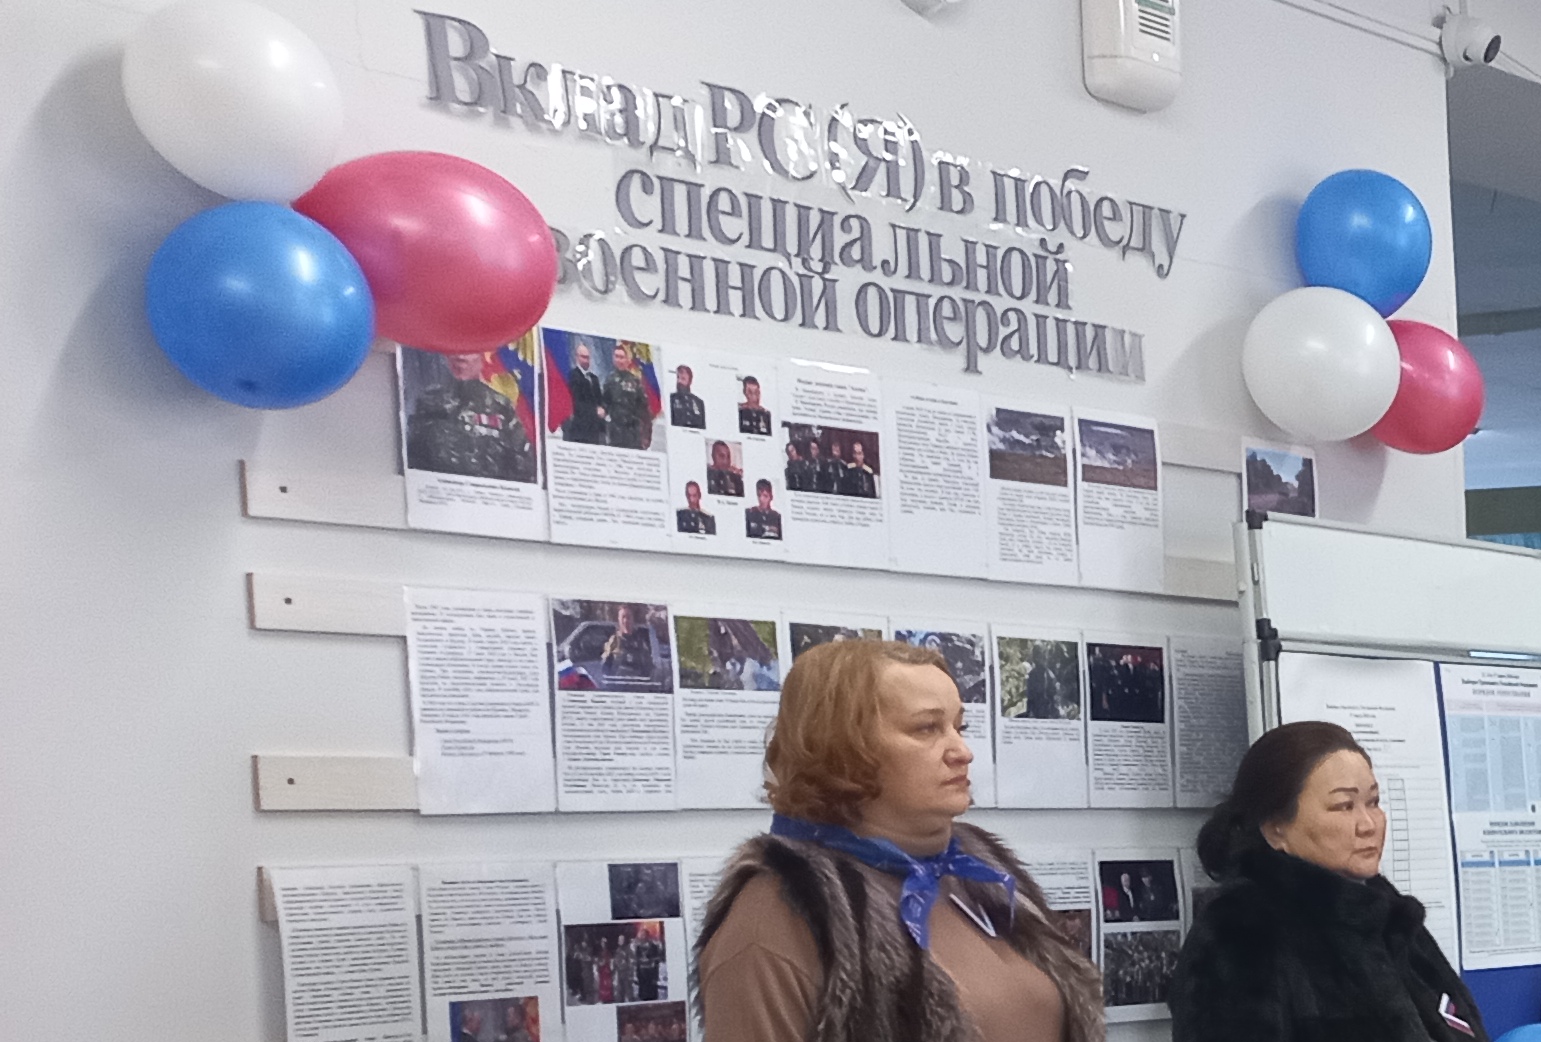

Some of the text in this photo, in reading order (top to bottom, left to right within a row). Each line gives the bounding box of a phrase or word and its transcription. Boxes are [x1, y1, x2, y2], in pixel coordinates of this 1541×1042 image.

[616, 166, 1073, 311] специальной
[989, 164, 1187, 279] победу
[855, 279, 1147, 382] операции
